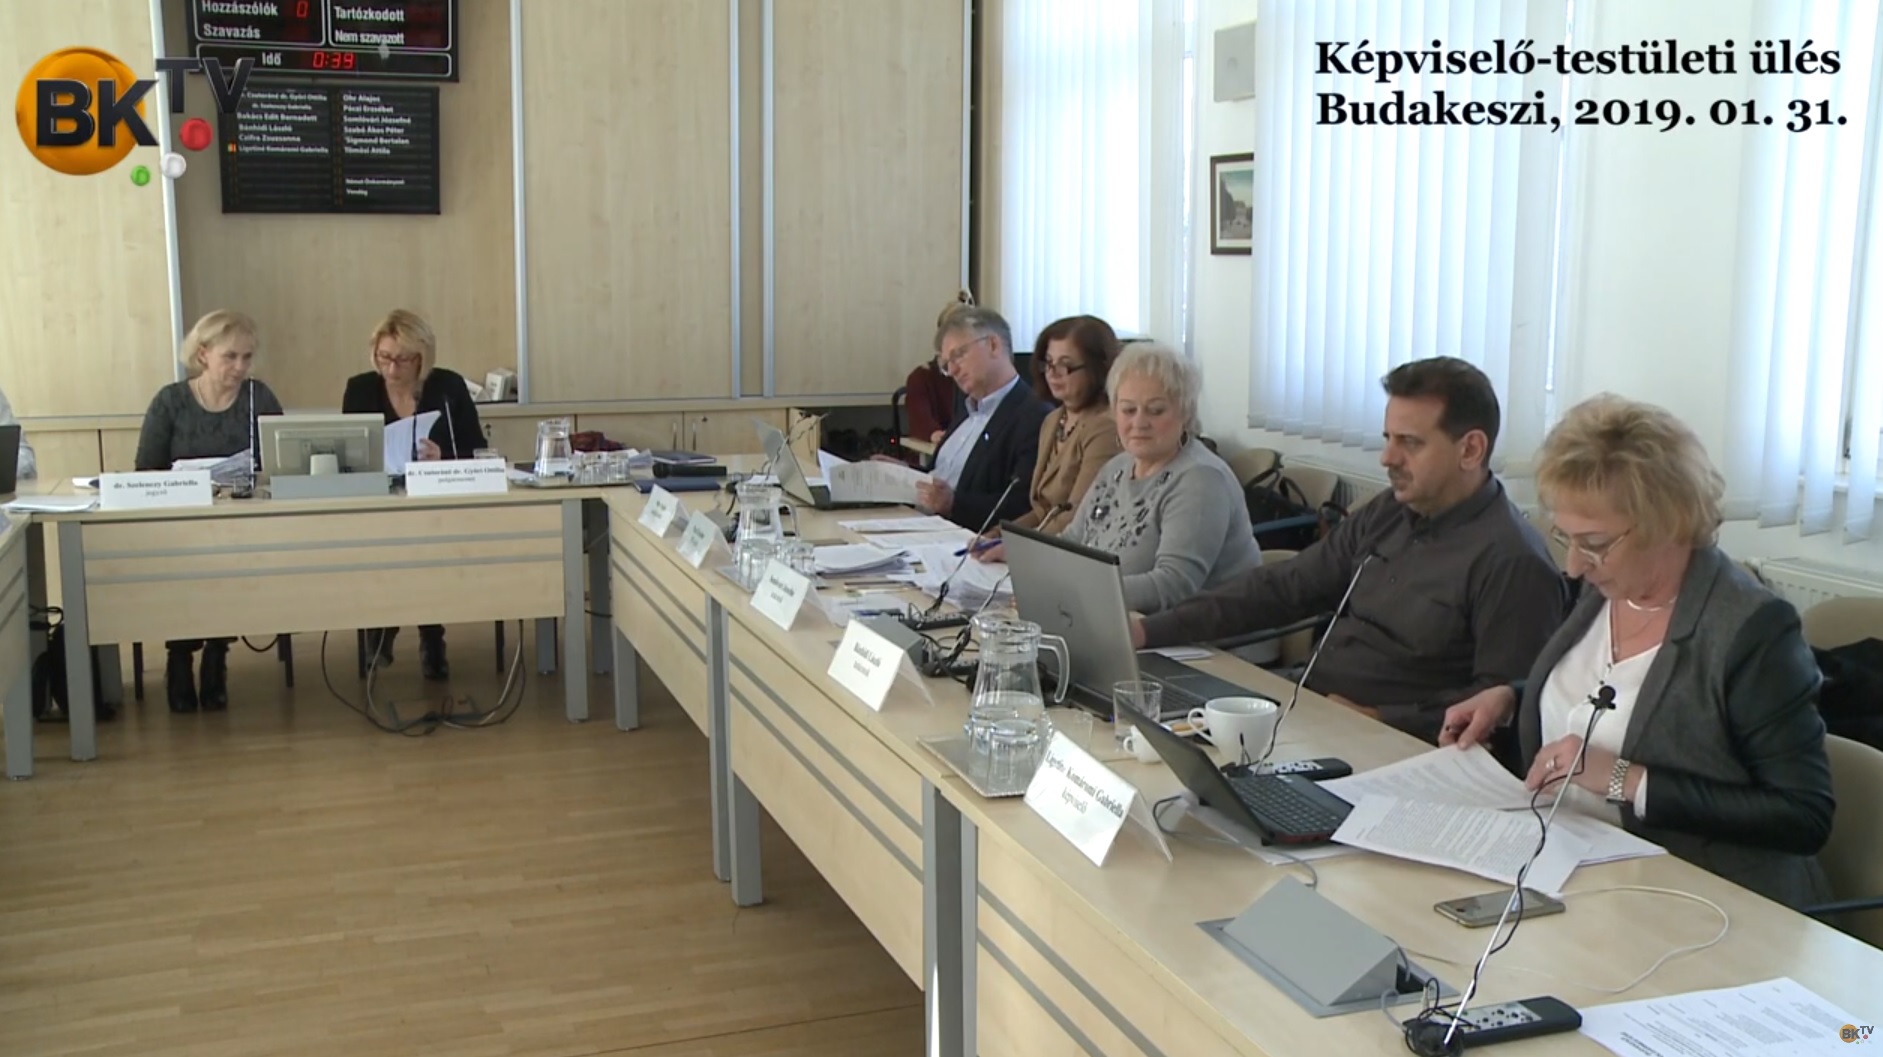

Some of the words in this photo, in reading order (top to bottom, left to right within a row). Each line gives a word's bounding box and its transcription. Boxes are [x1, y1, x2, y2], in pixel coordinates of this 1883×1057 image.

[201, 0, 279, 16] Hozzászólók
[334, 5, 405, 22] Tartózkodott
[203, 23, 261, 39] Szavazás
[334, 31, 358, 43] Nem
[360, 34, 405, 45] szavazott
[261, 51, 282, 66] Idő
[312, 52, 355, 69] 0:39
